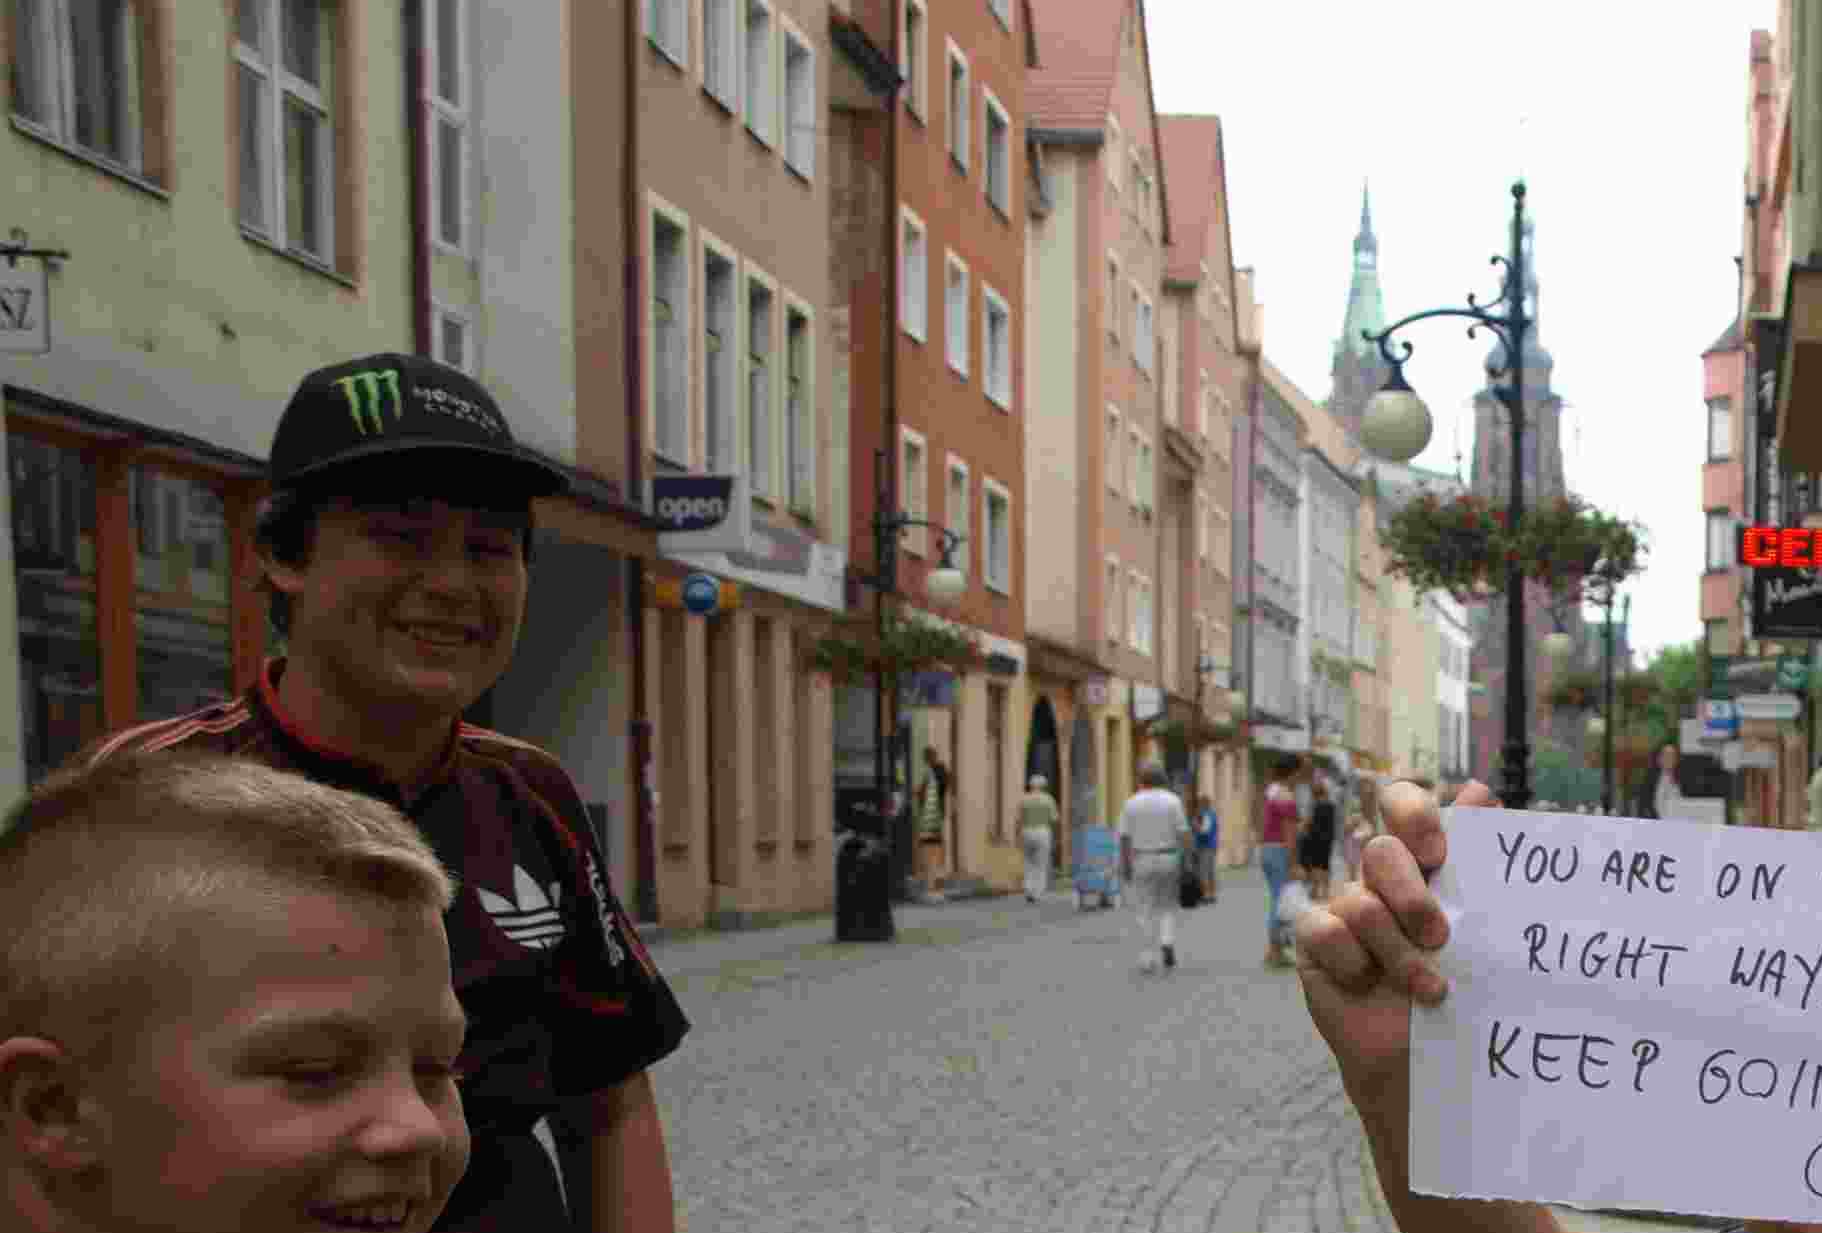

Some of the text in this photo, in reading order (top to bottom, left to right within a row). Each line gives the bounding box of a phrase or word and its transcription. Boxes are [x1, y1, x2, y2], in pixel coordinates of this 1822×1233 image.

[657, 496, 724, 526] open
[1497, 831, 1579, 885] YOU
[1600, 849, 1678, 894] ARE
[1717, 862, 1787, 901] ON
[1523, 923, 1689, 987] RIGHT
[1487, 1020, 1662, 1093] KEEP
